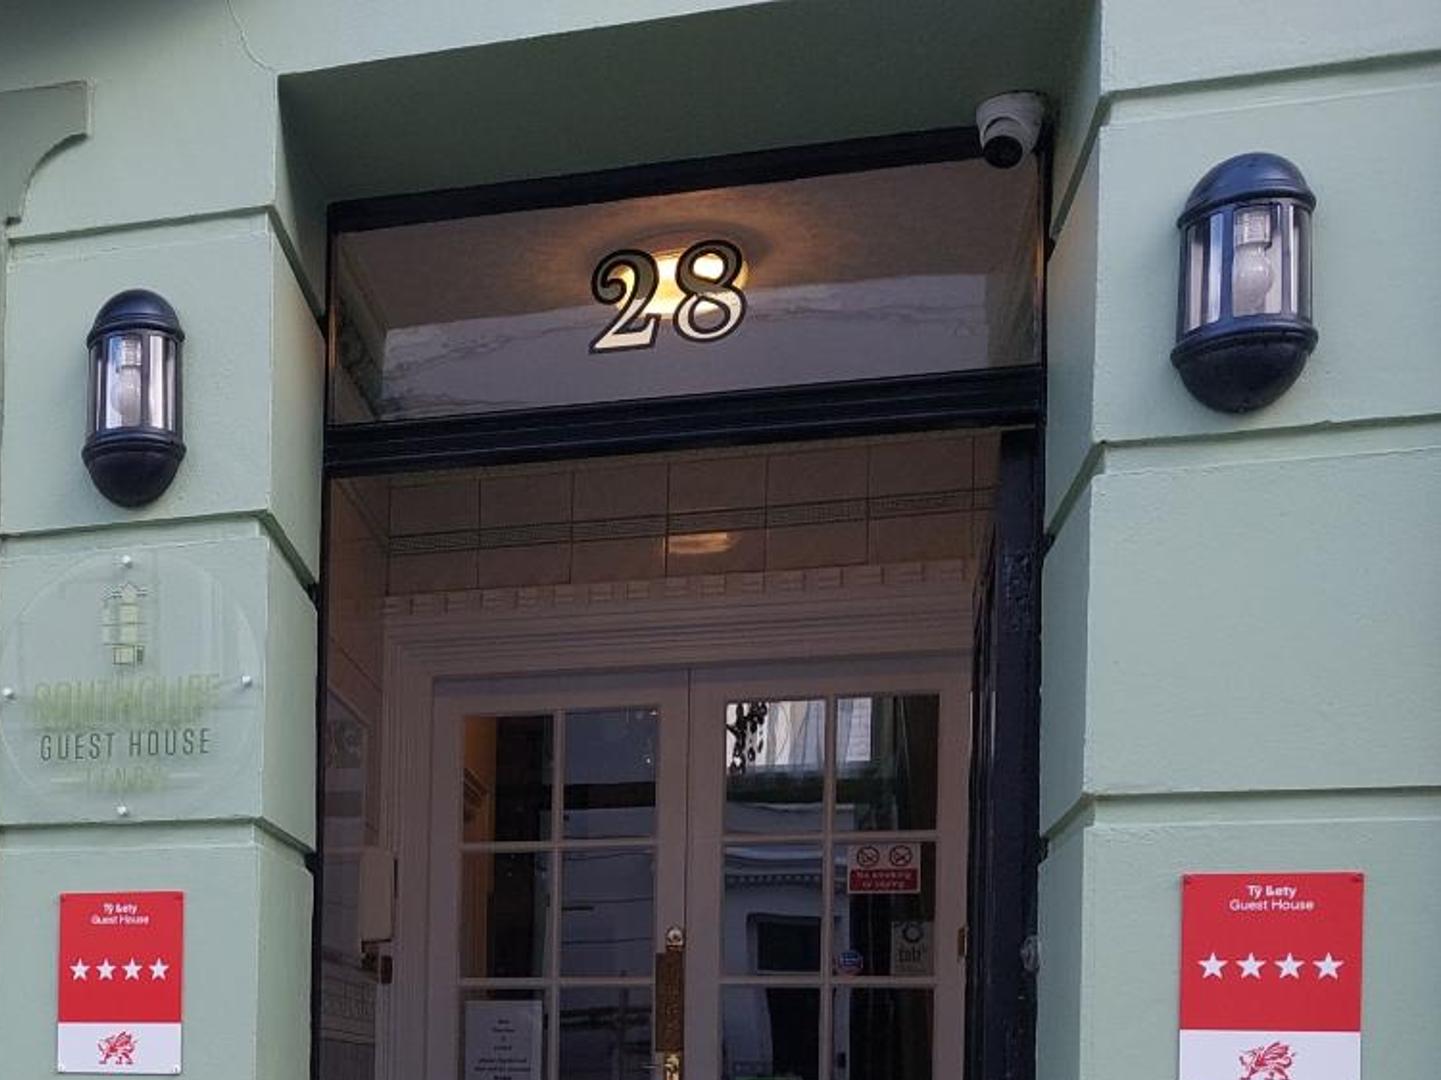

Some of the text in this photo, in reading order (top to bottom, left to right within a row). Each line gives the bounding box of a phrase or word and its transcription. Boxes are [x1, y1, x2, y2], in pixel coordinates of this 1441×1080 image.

[589, 239, 747, 354] 28
[40, 727, 211, 762] GUEST HOUSE
[1229, 898, 1315, 912] Guest House
